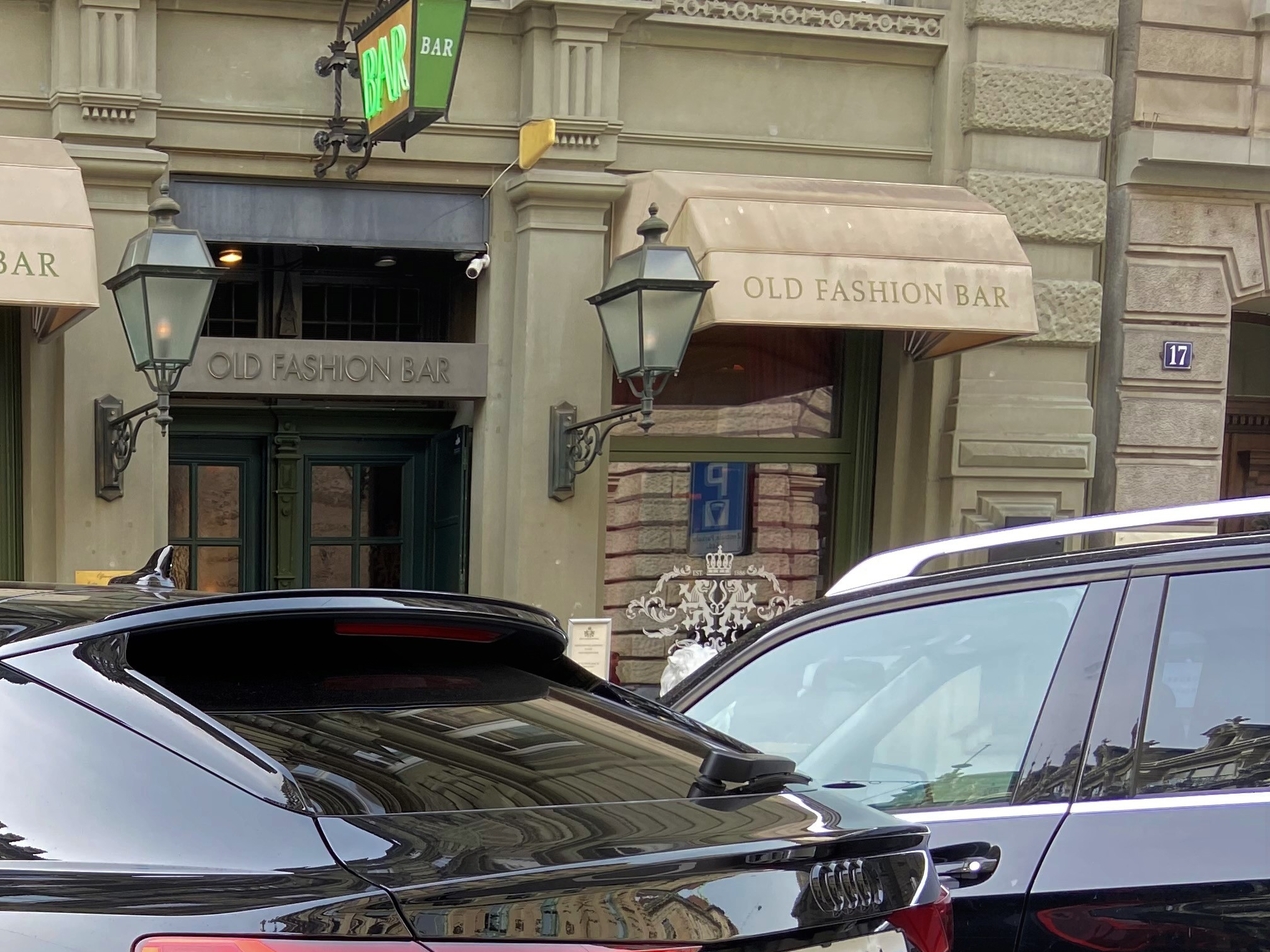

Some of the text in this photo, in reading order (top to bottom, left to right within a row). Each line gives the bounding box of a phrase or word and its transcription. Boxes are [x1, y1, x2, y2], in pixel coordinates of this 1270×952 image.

[420, 36, 454, 57] BAR
[362, 24, 410, 120] BAR
[743, 275, 1010, 308] OLD FASHION BAR
[207, 351, 450, 384] OLD FASHION BAR
[1169, 344, 1188, 365] 17
